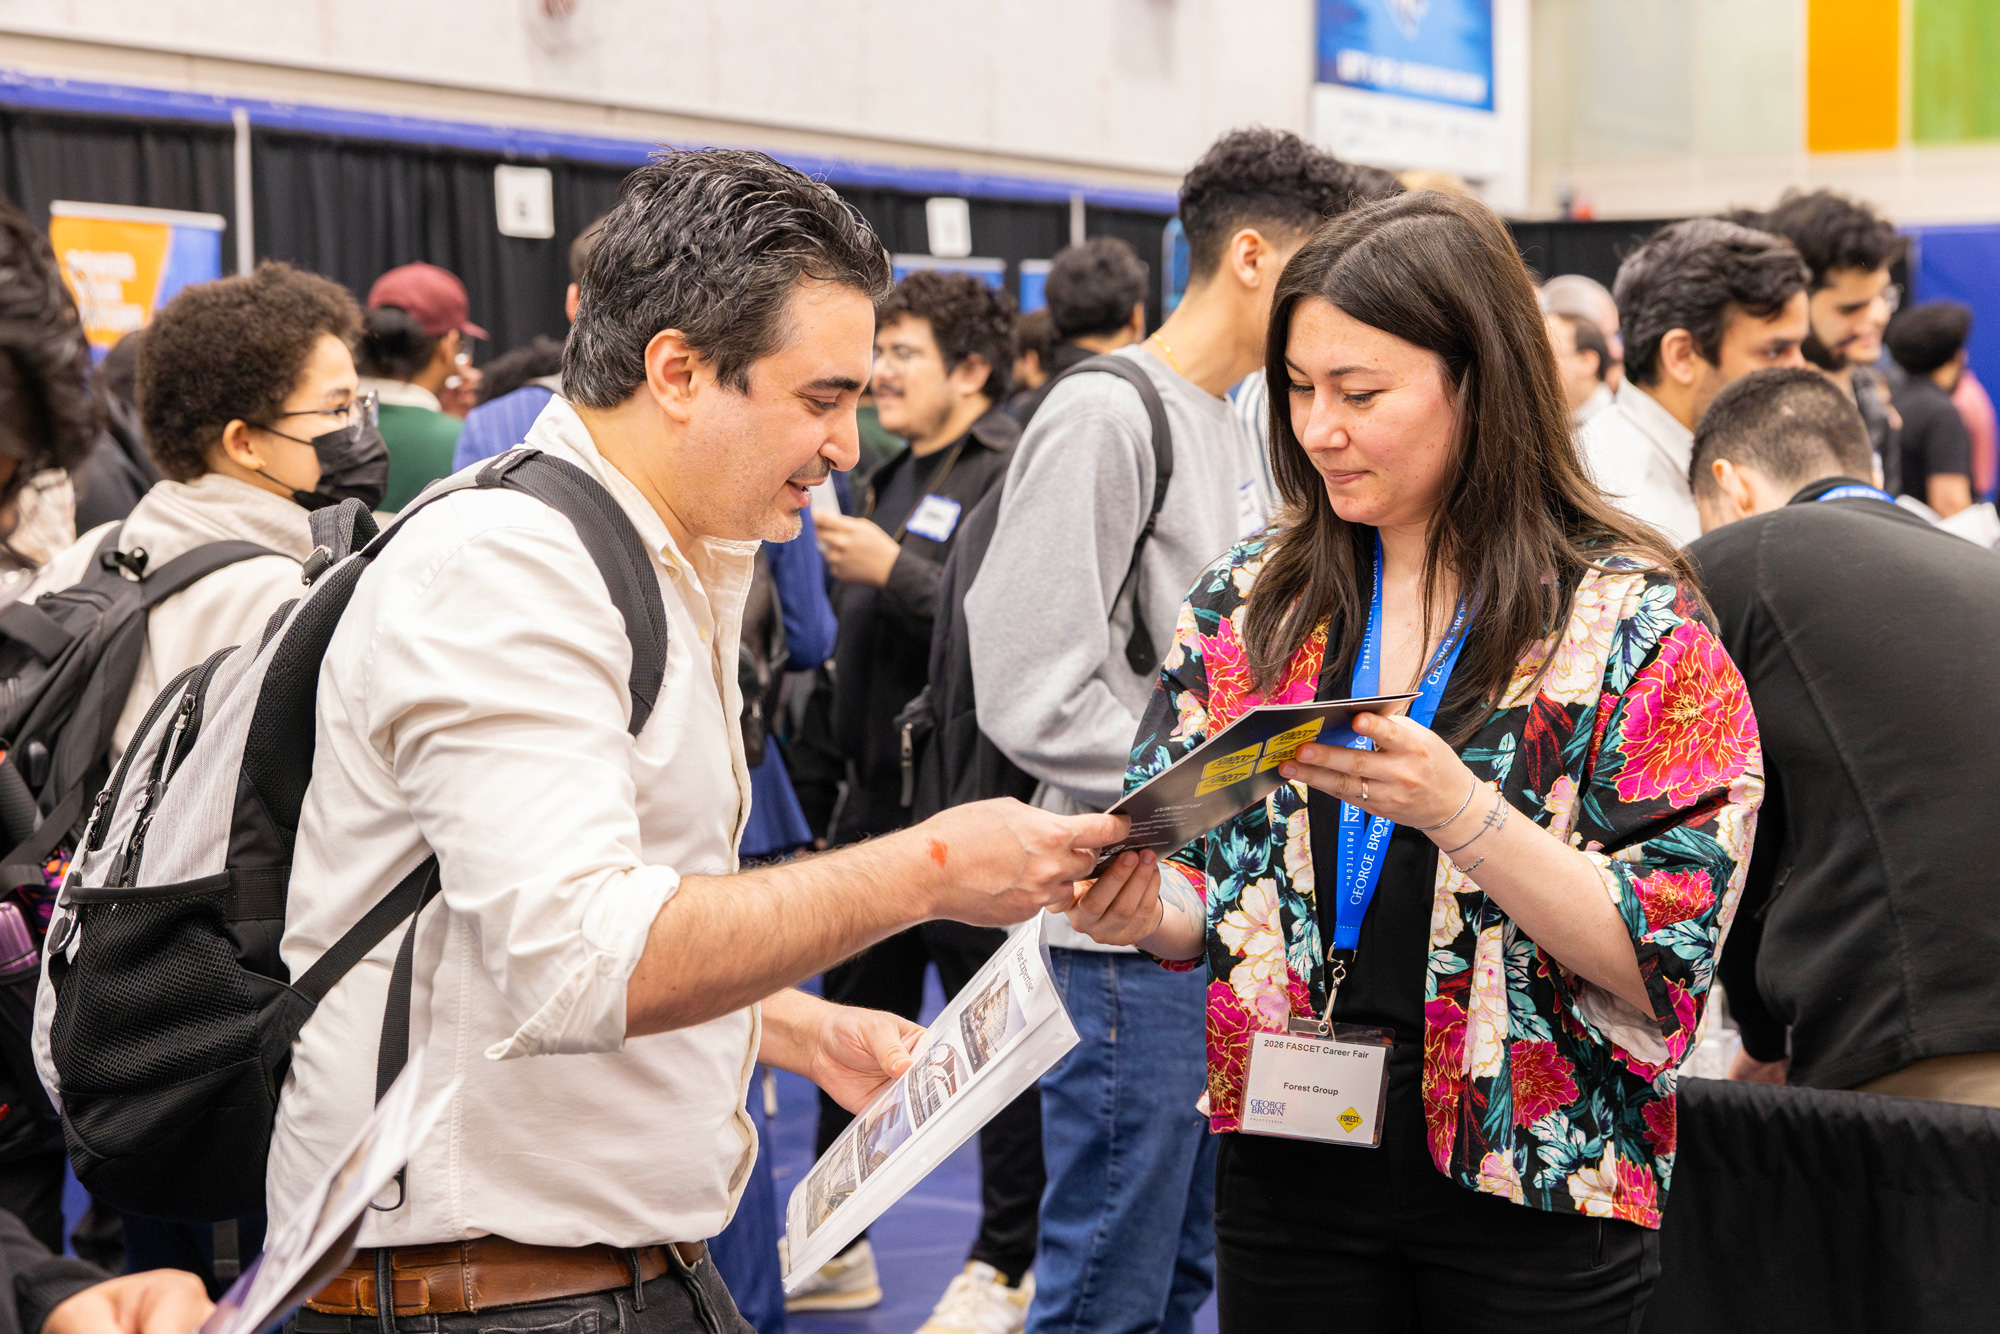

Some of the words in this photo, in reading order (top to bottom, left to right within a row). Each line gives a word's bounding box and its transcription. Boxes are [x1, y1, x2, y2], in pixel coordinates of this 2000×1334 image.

[1350, 853, 1375, 905] GEORGE
[1367, 815, 1386, 851] BROW
[1016, 947, 1024, 961] Our
[1018, 959, 1034, 993] Expertise
[1264, 1040, 1284, 1049] 2026
[1286, 1042, 1321, 1053] FASCET
[1322, 1046, 1351, 1057] Career
[1352, 1050, 1369, 1059] Fair
[1283, 1082, 1310, 1092] Forest
[1312, 1085, 1339, 1097] Group
[1250, 1098, 1287, 1110] GEORGE
[1251, 1106, 1286, 1117] BROWN
[1340, 1114, 1360, 1124] FOREST
